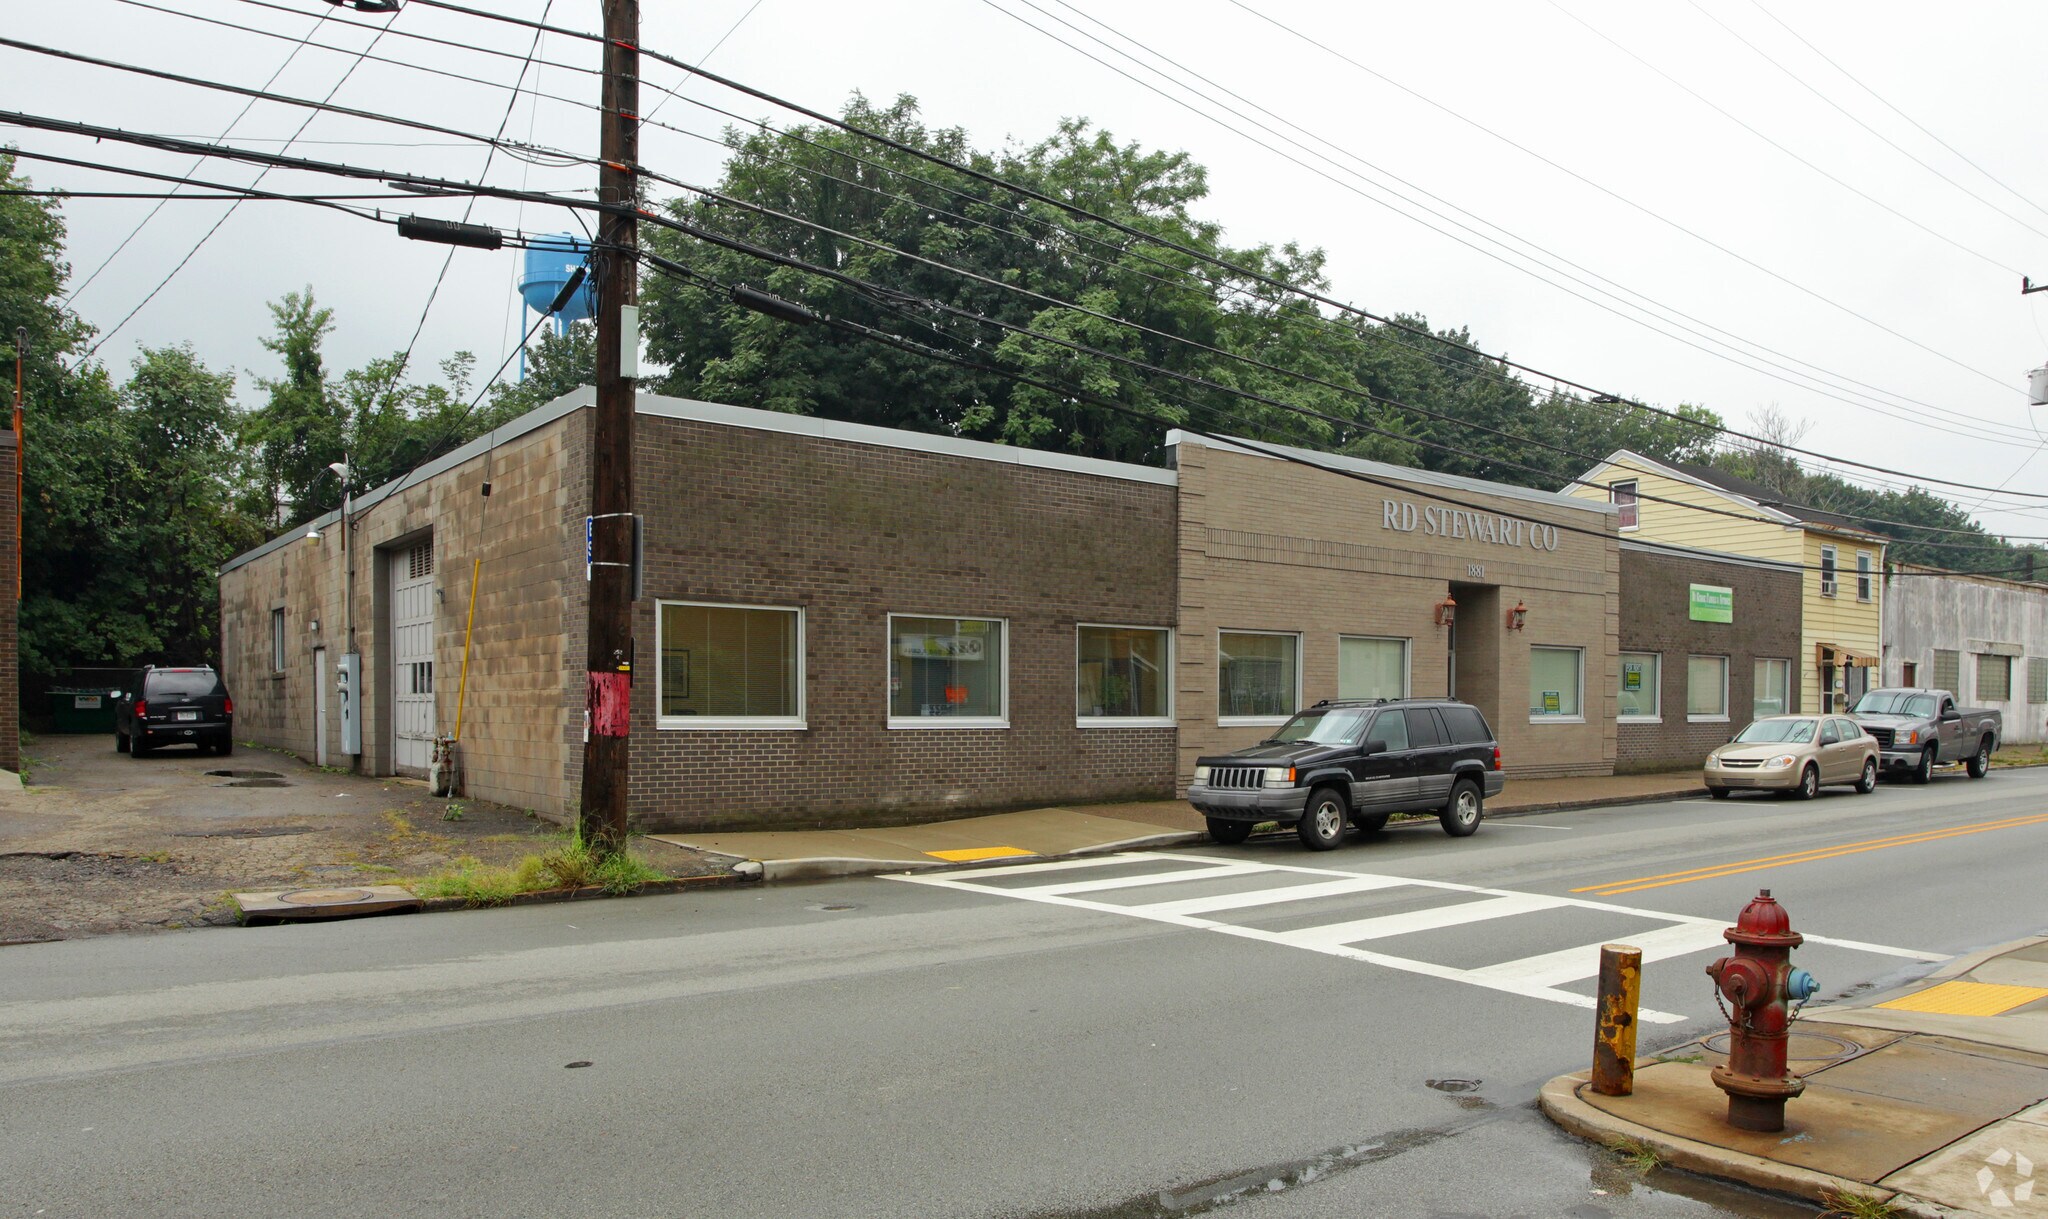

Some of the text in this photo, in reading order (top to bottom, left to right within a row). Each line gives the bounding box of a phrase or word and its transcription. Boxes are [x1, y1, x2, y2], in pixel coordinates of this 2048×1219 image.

[1382, 499, 1559, 552] RD STEWART CO
[1467, 563, 1485, 578] 1881
